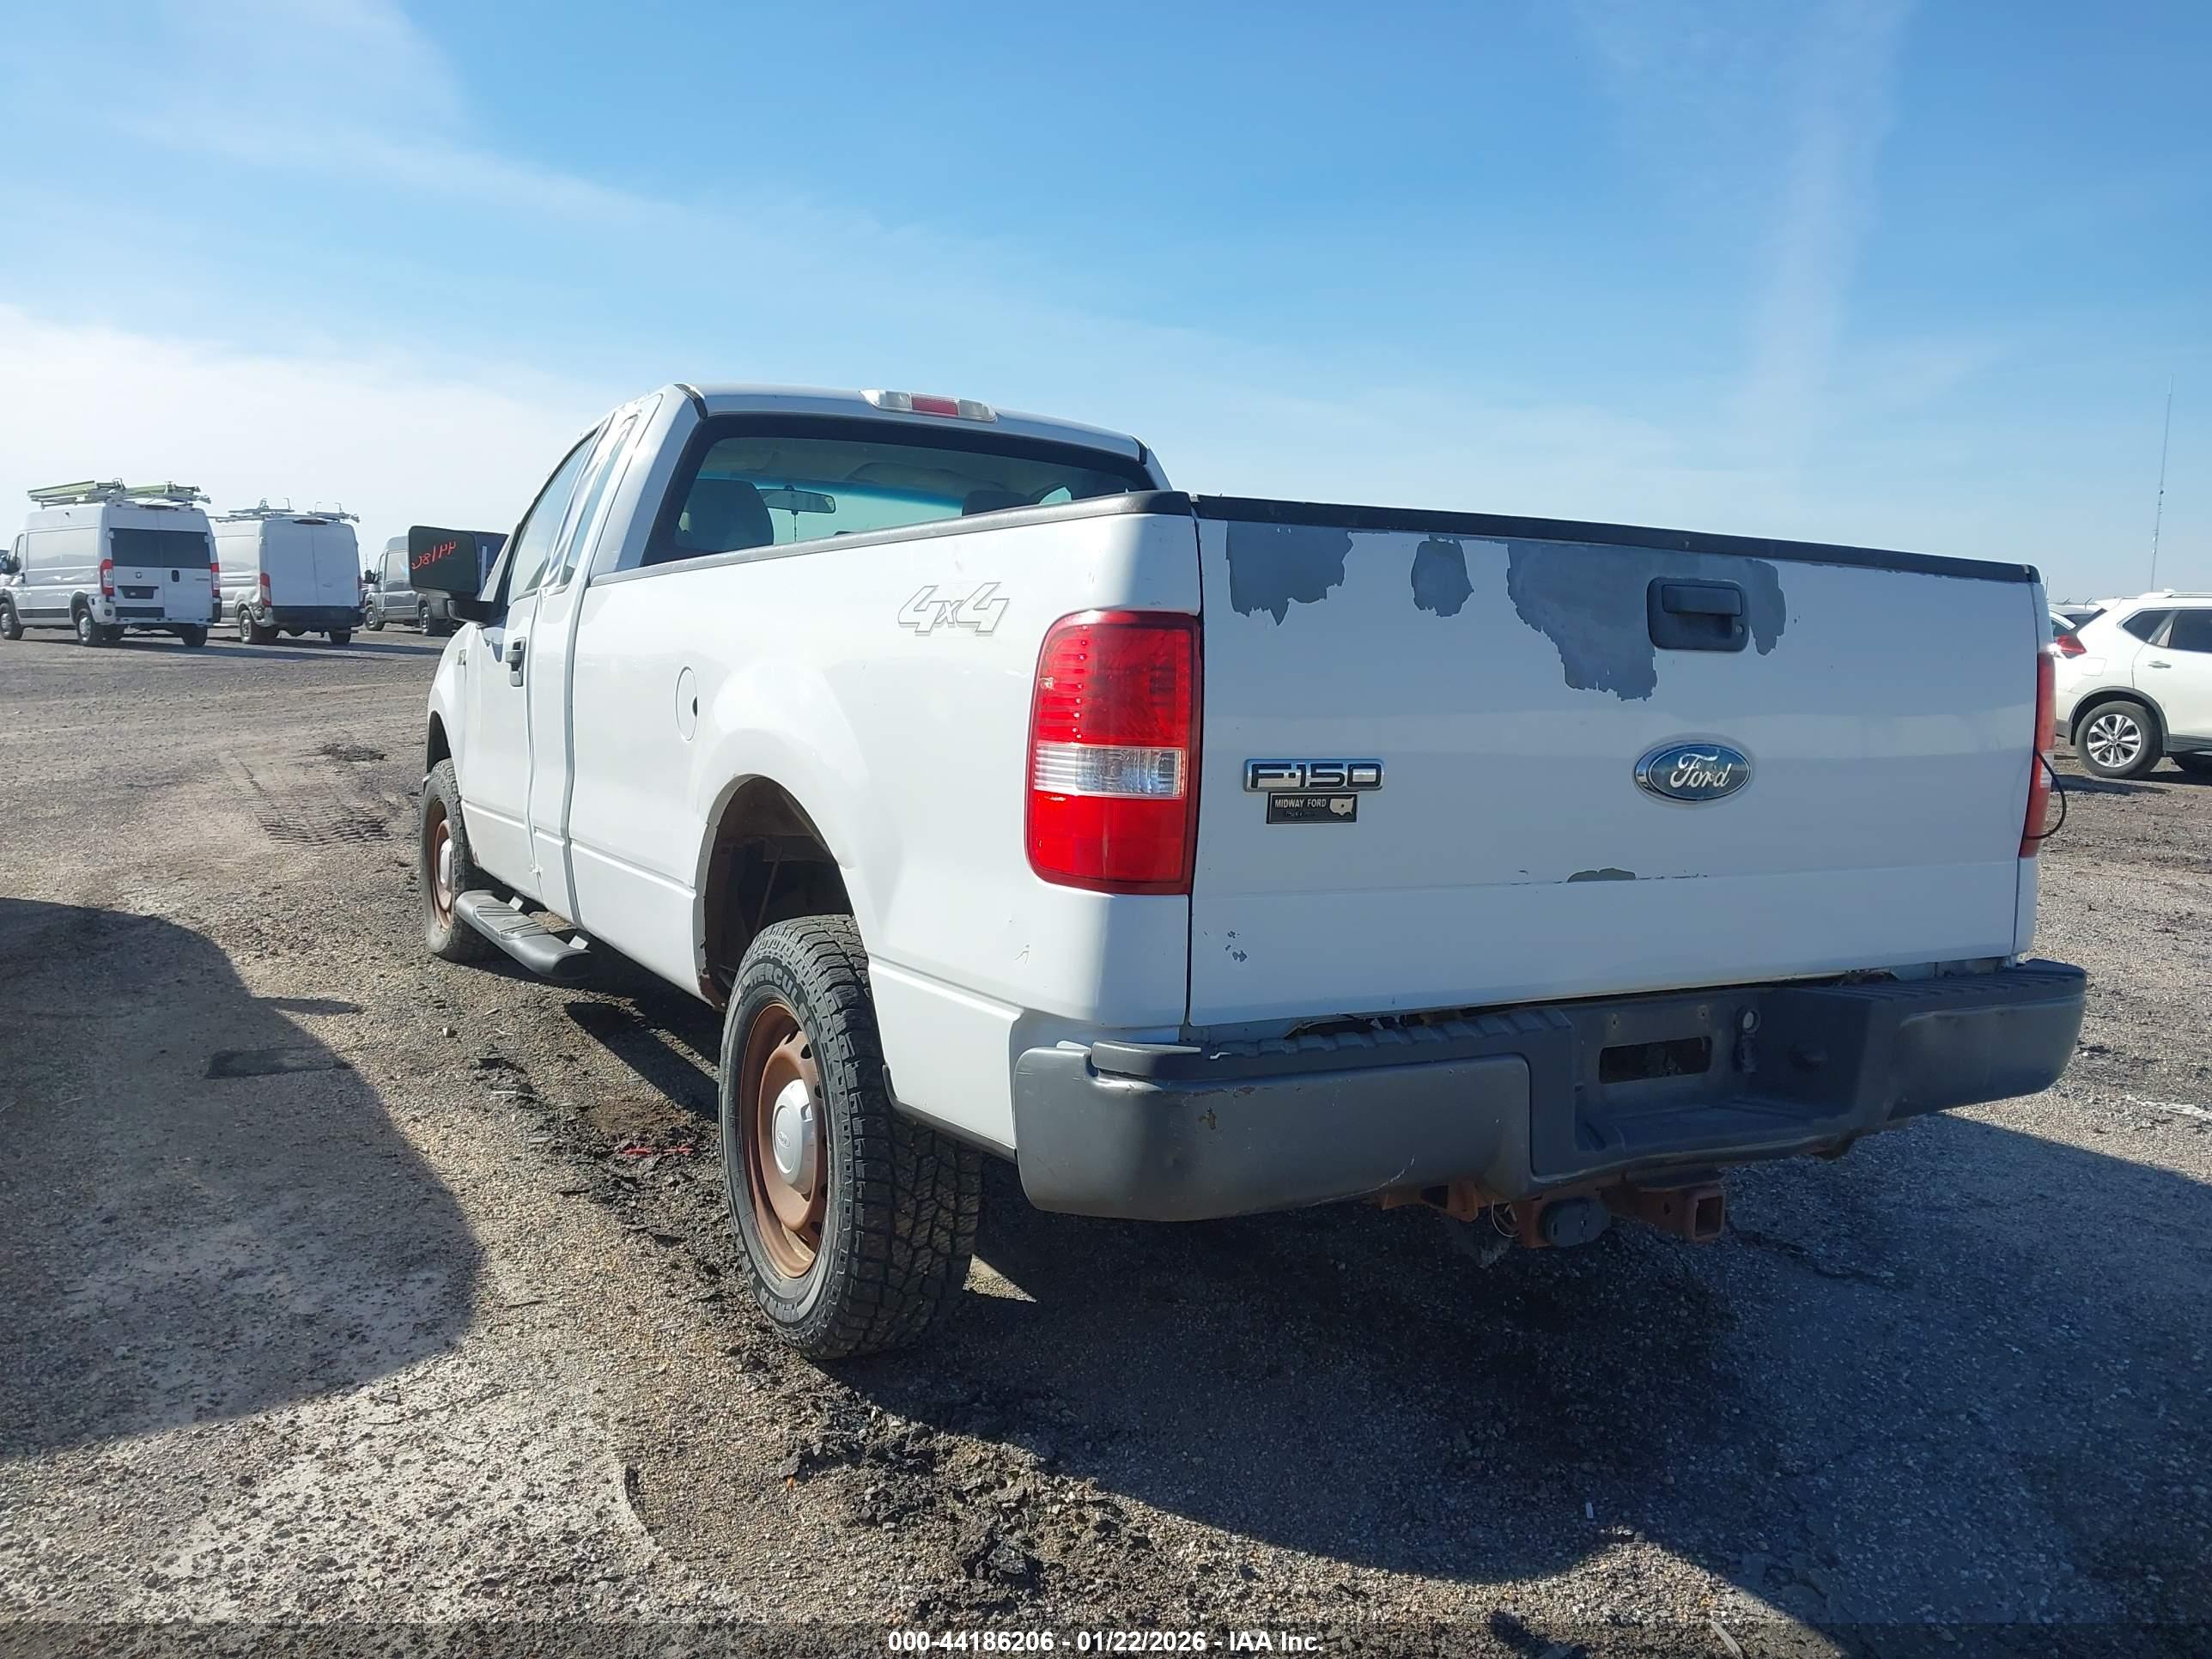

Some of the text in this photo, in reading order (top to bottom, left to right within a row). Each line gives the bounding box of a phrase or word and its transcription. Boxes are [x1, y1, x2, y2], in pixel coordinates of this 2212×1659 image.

[896, 581, 1011, 636] 4x4
[1668, 753, 1732, 790] Ford
[1274, 798, 1327, 808] MIDWAY FORD
[749, 963, 816, 1044] HERCULES
